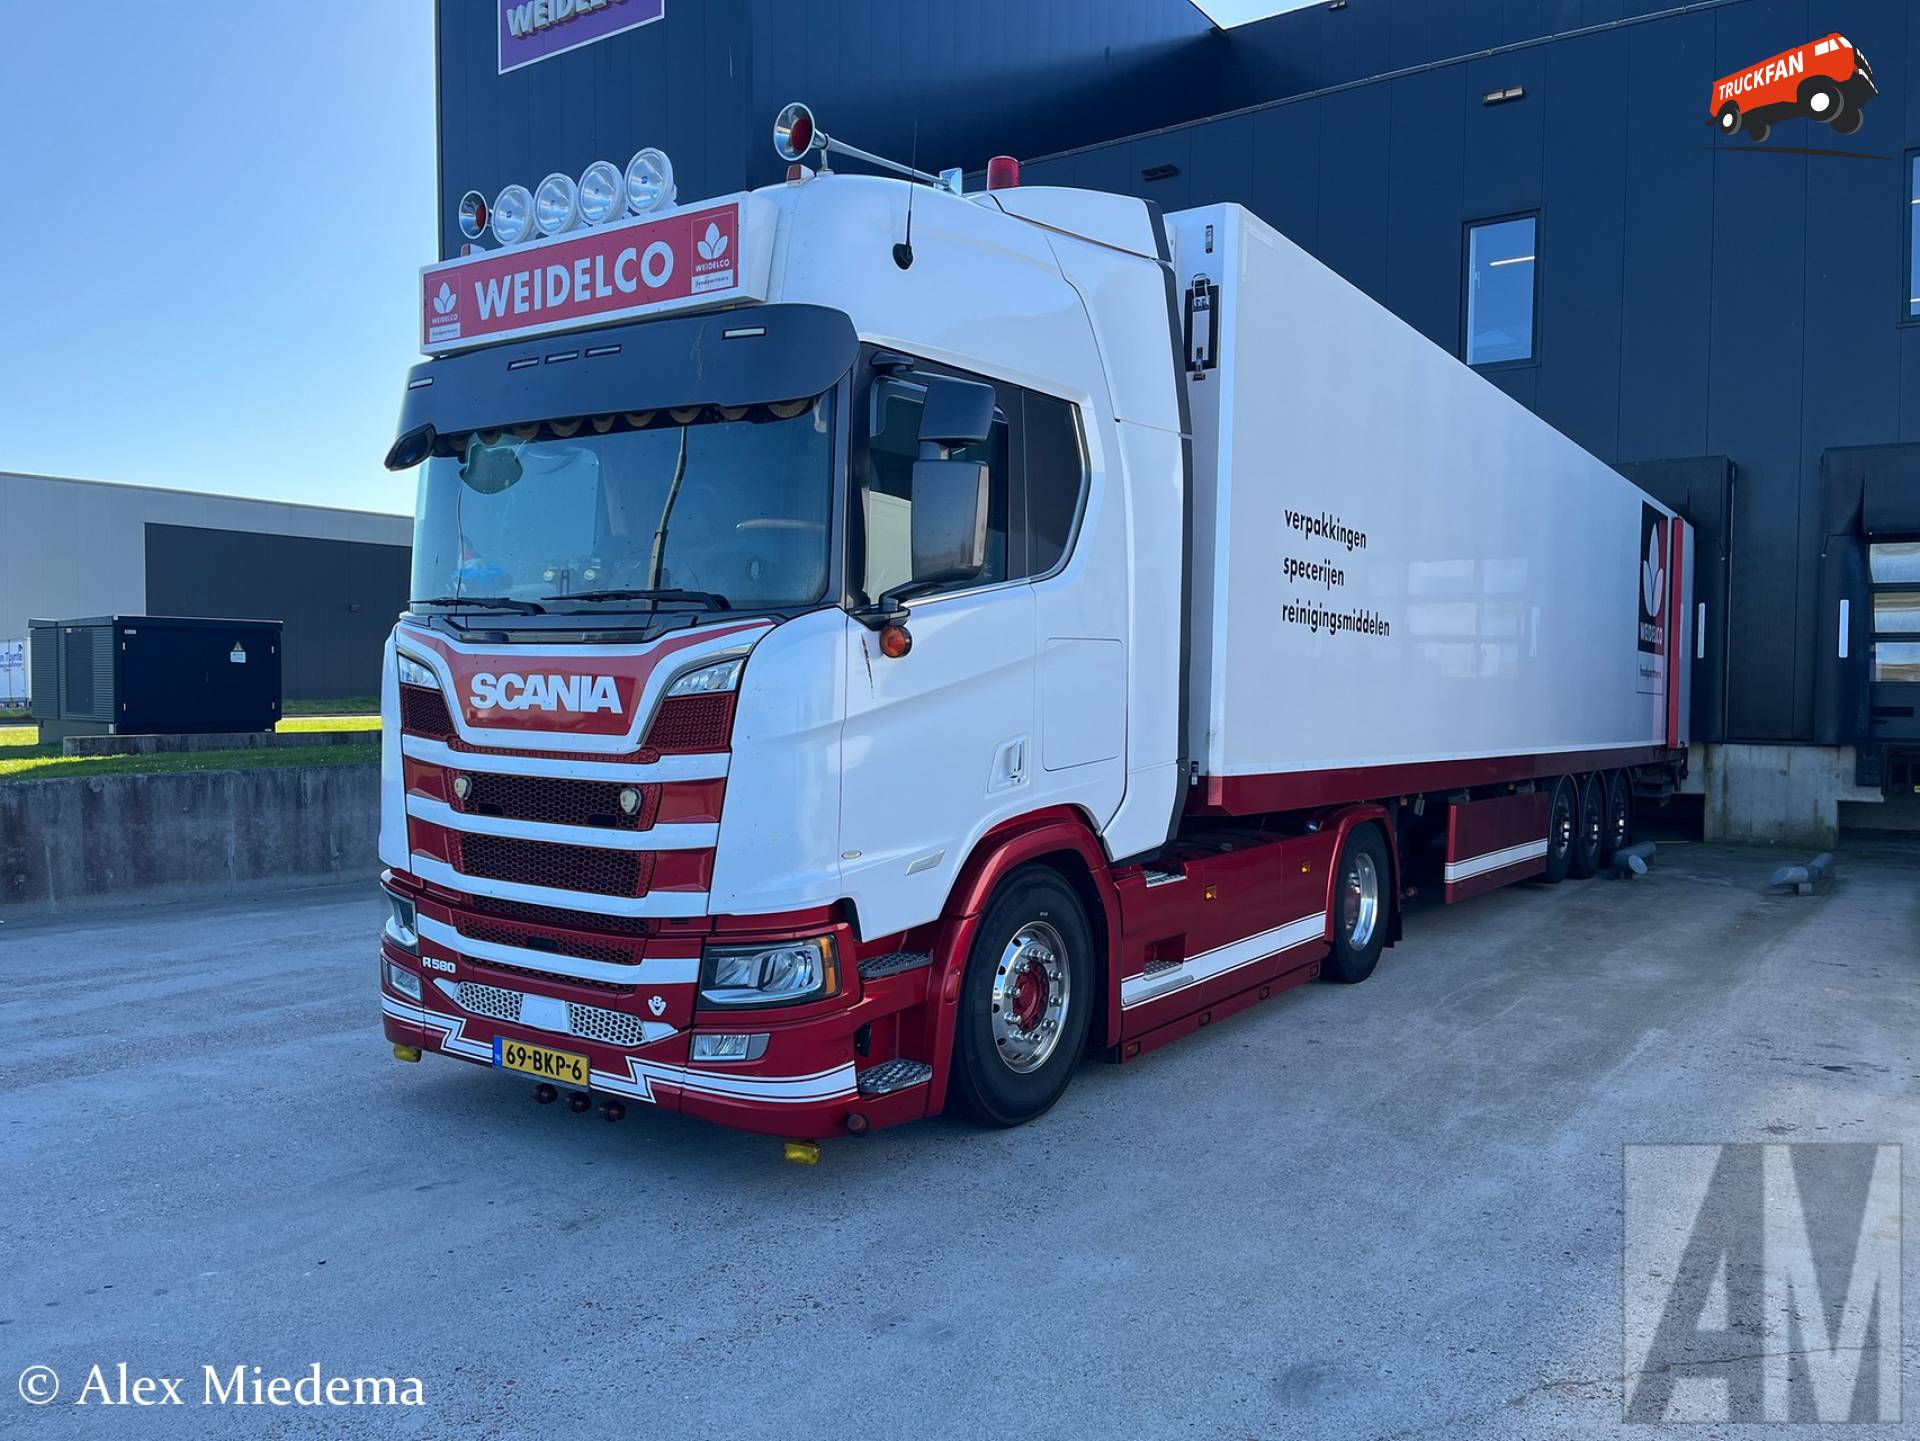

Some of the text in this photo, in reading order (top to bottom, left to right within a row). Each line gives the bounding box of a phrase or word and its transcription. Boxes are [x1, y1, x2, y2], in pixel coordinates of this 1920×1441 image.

[474, 240, 674, 321] WEIDELCO
[694, 258, 730, 272] WEIDELCO
[1284, 509, 1367, 552] verpakkingen
[1283, 556, 1345, 591] specerijen
[1282, 597, 1390, 637] reinigingsmiddelen
[469, 672, 623, 714] SCANIA
[506, 1044, 582, 1080] 69-BKP-6
